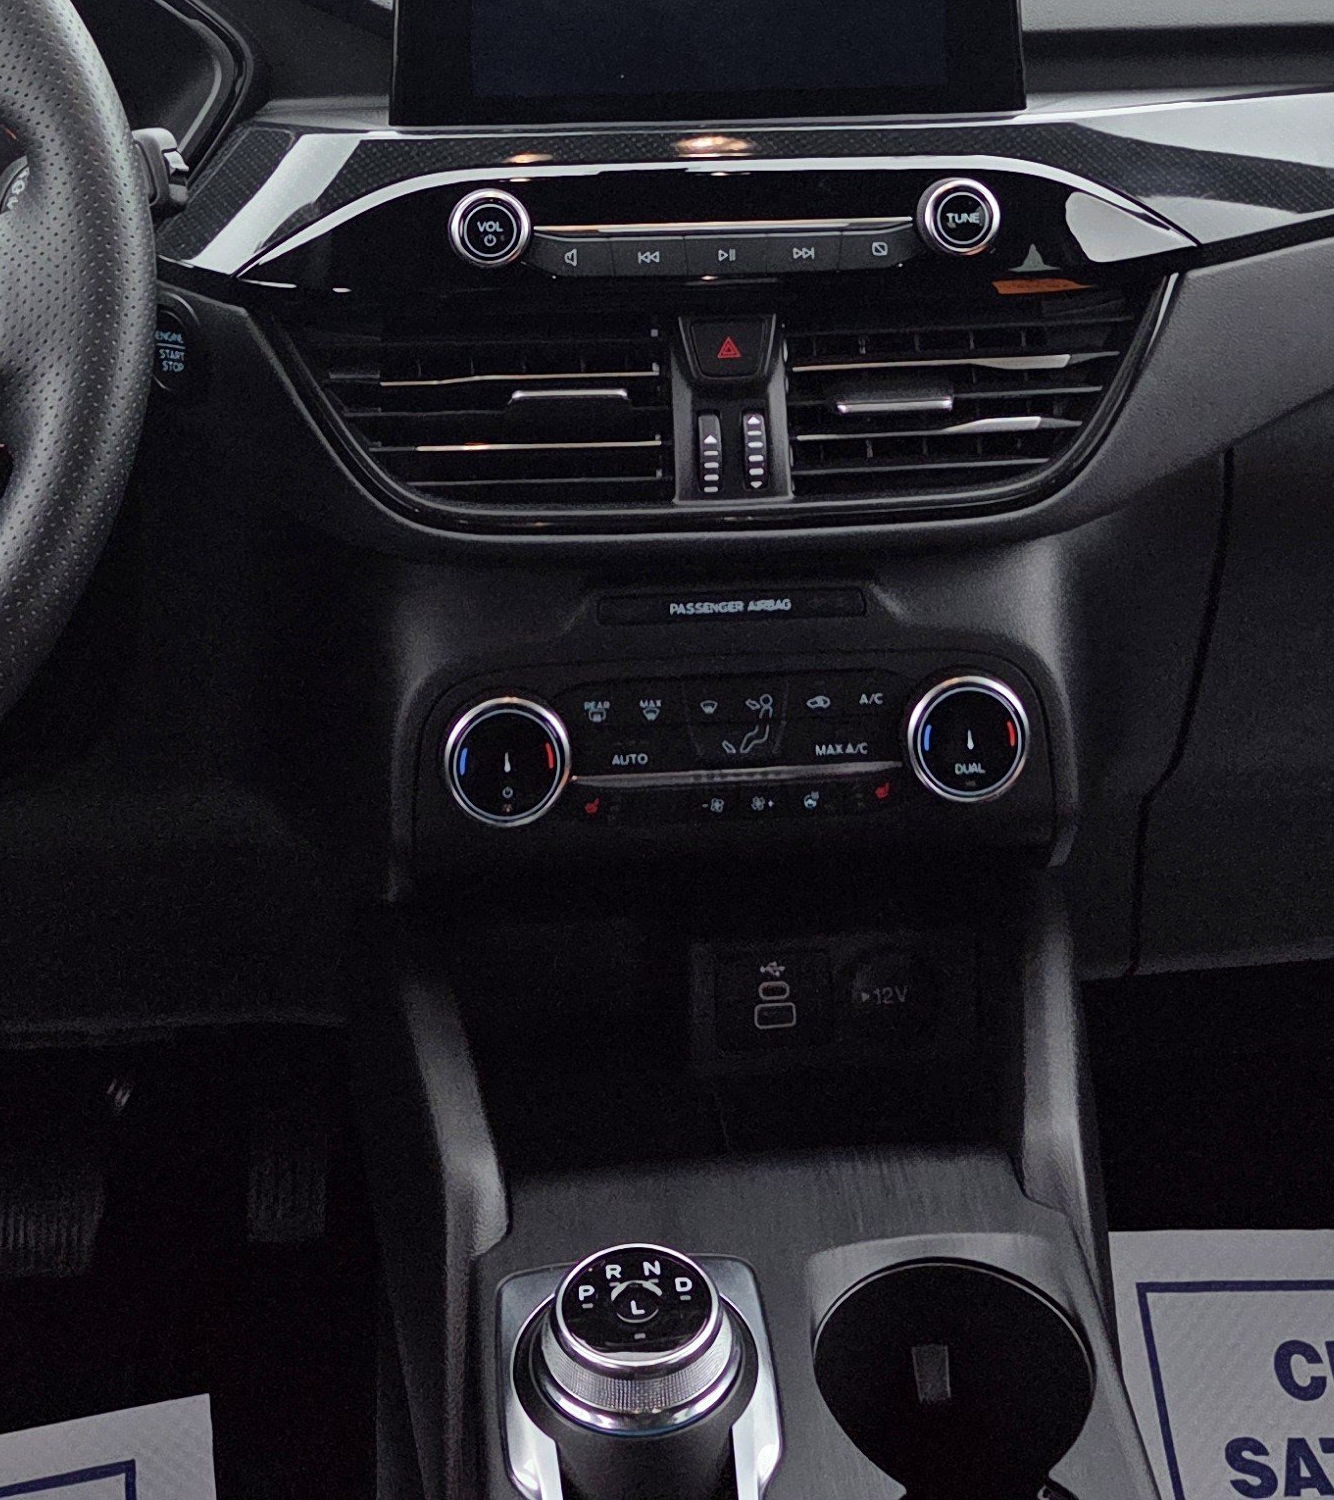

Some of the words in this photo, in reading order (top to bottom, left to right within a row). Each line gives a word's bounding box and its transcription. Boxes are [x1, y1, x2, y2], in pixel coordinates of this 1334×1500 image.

[945, 212, 980, 224] TUNE
[476, 220, 504, 232] VOL
[158, 348, 185, 361] START
[161, 360, 185, 373] STOP
[669, 600, 745, 616] PASSENGER
[747, 598, 792, 612] AIRBAG
[639, 699, 663, 709] MAX
[858, 692, 884, 705] A/C
[583, 700, 611, 711] REAR
[814, 743, 844, 757] MAX
[845, 741, 869, 755] A/C
[611, 752, 649, 766] AUTO
[954, 762, 986, 775] DUAL
[874, 986, 909, 1005] 12V
[578, 1284, 596, 1301] P
[605, 1264, 622, 1280] R
[642, 1260, 662, 1276] N
[674, 1276, 693, 1292] D
[630, 1300, 646, 1316] L
